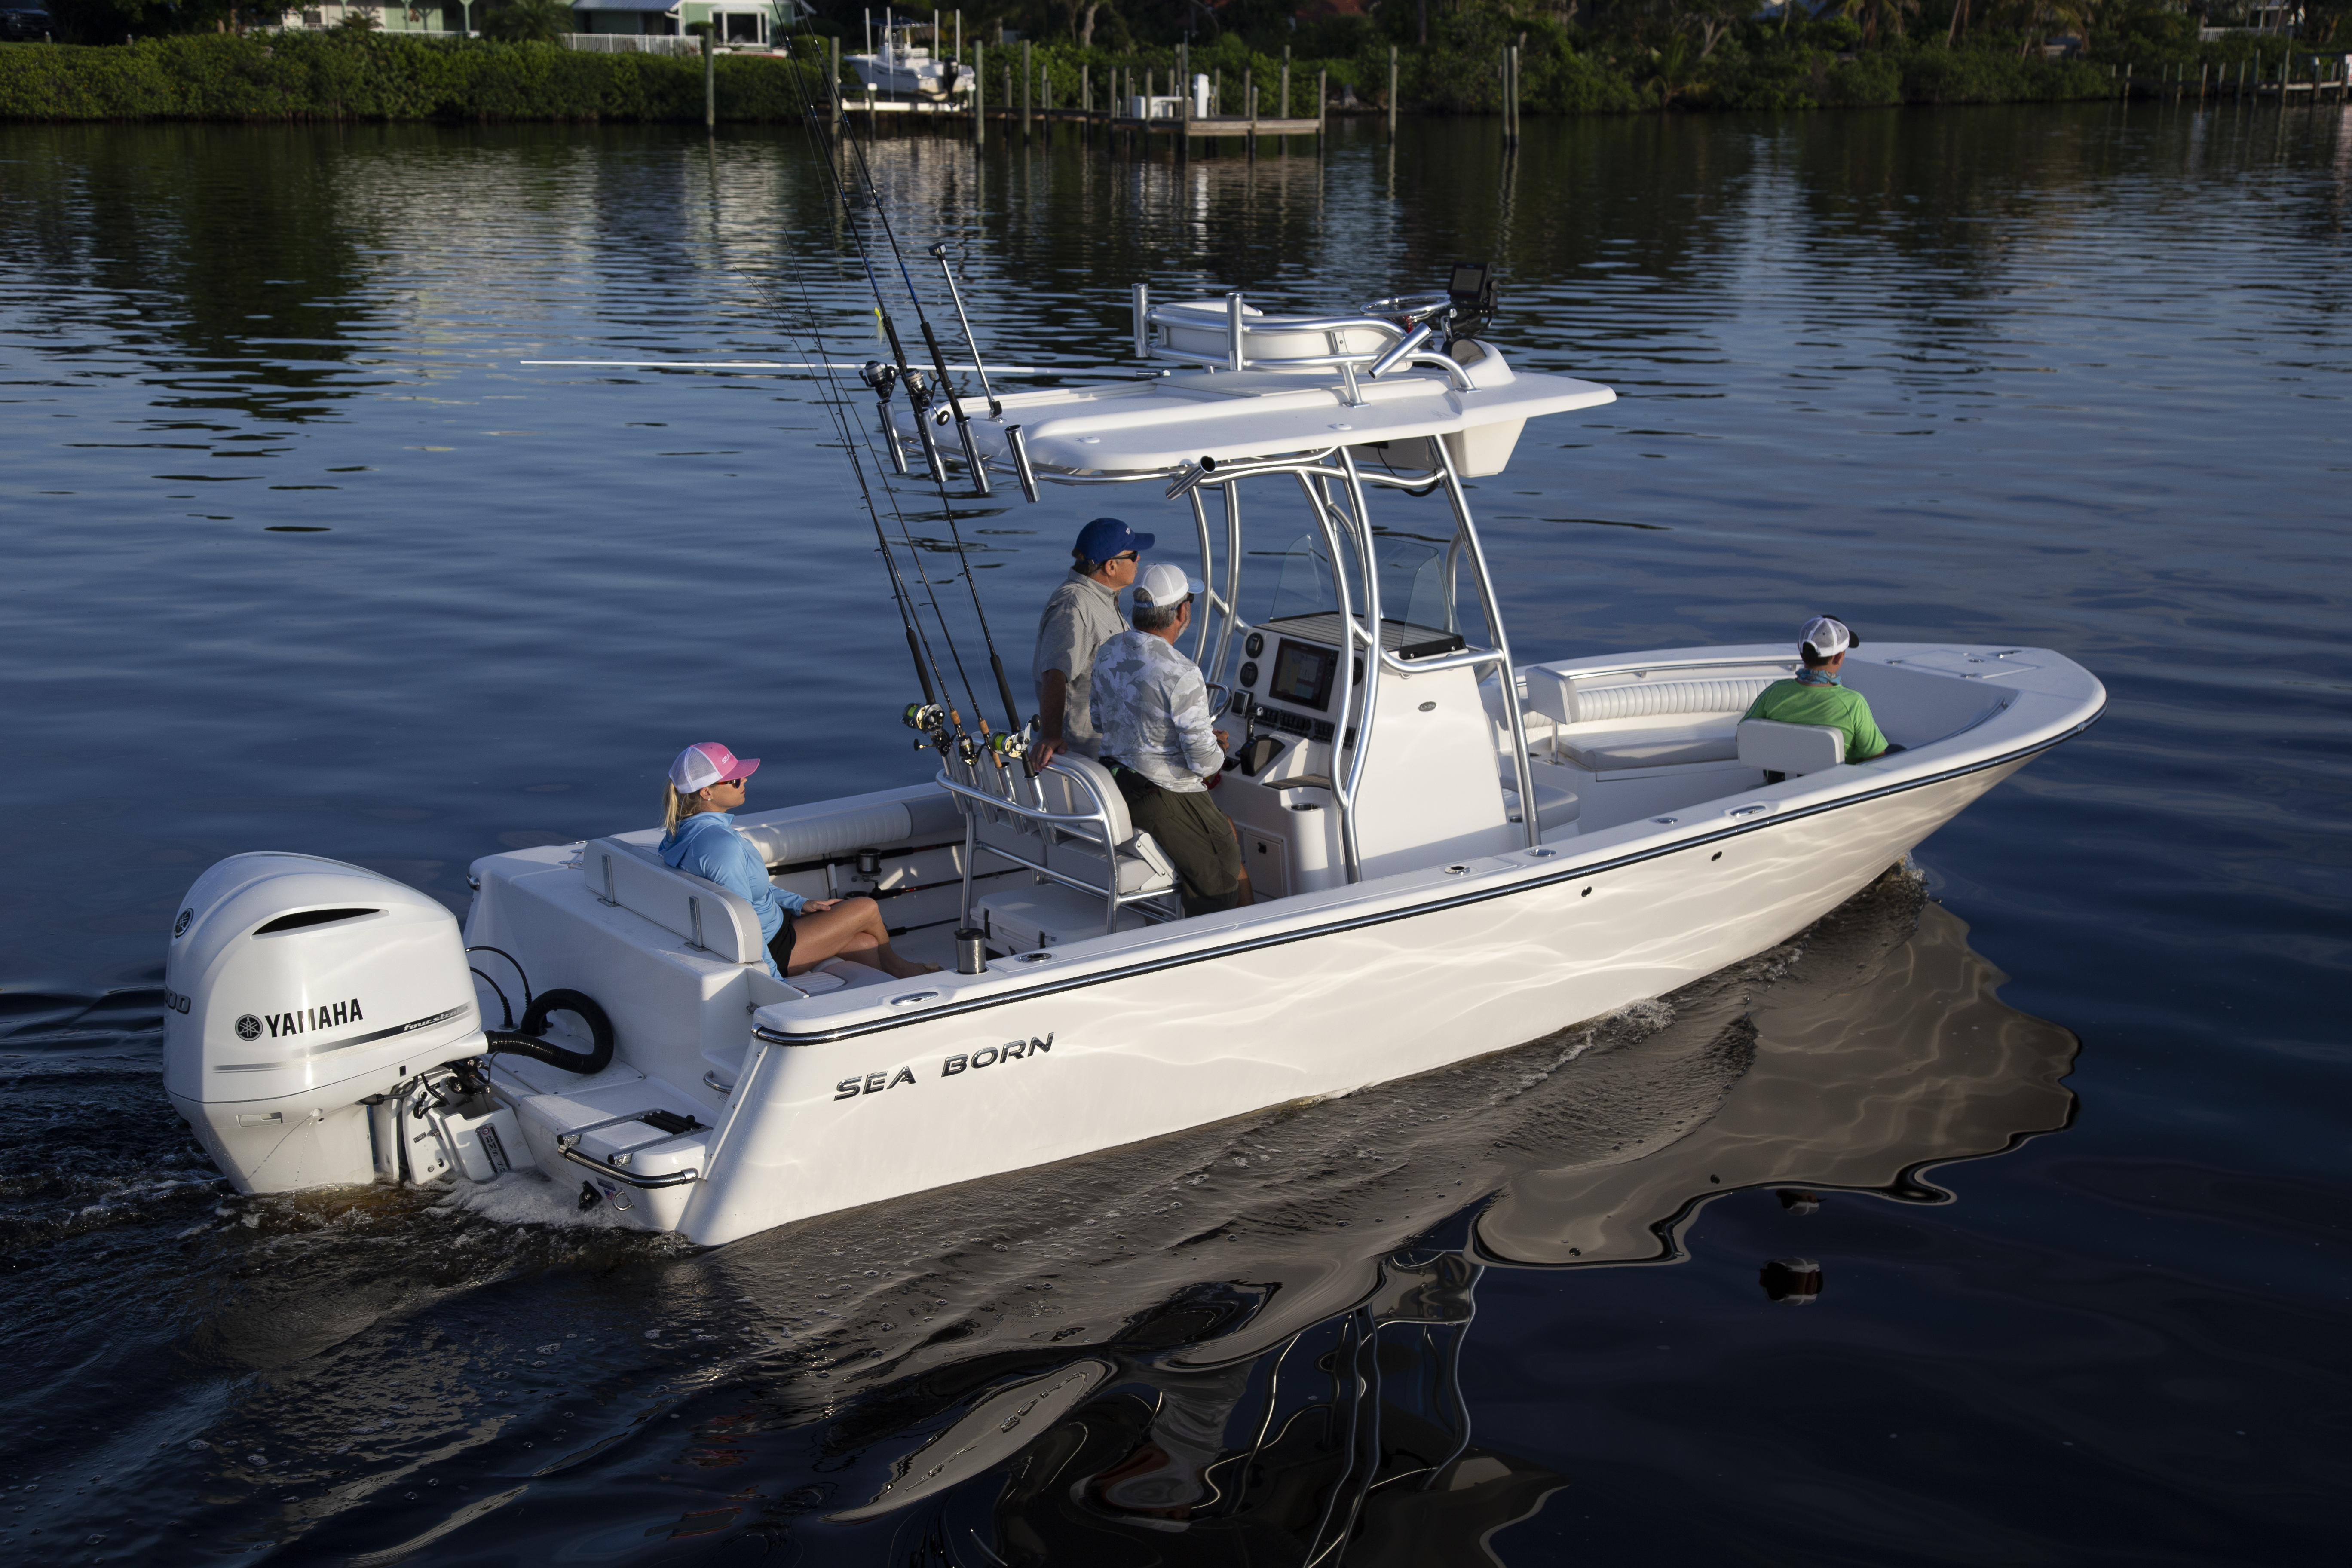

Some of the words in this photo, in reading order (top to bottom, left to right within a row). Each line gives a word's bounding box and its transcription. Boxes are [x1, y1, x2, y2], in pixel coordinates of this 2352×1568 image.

[722, 754, 730, 764] SEA
[164, 985, 191, 1014] 00
[264, 998, 363, 1038] YAMAHA
[833, 1065, 916, 1101] SEA
[941, 1032, 1054, 1078] BORN
[485, 1136, 498, 1157] BMS
